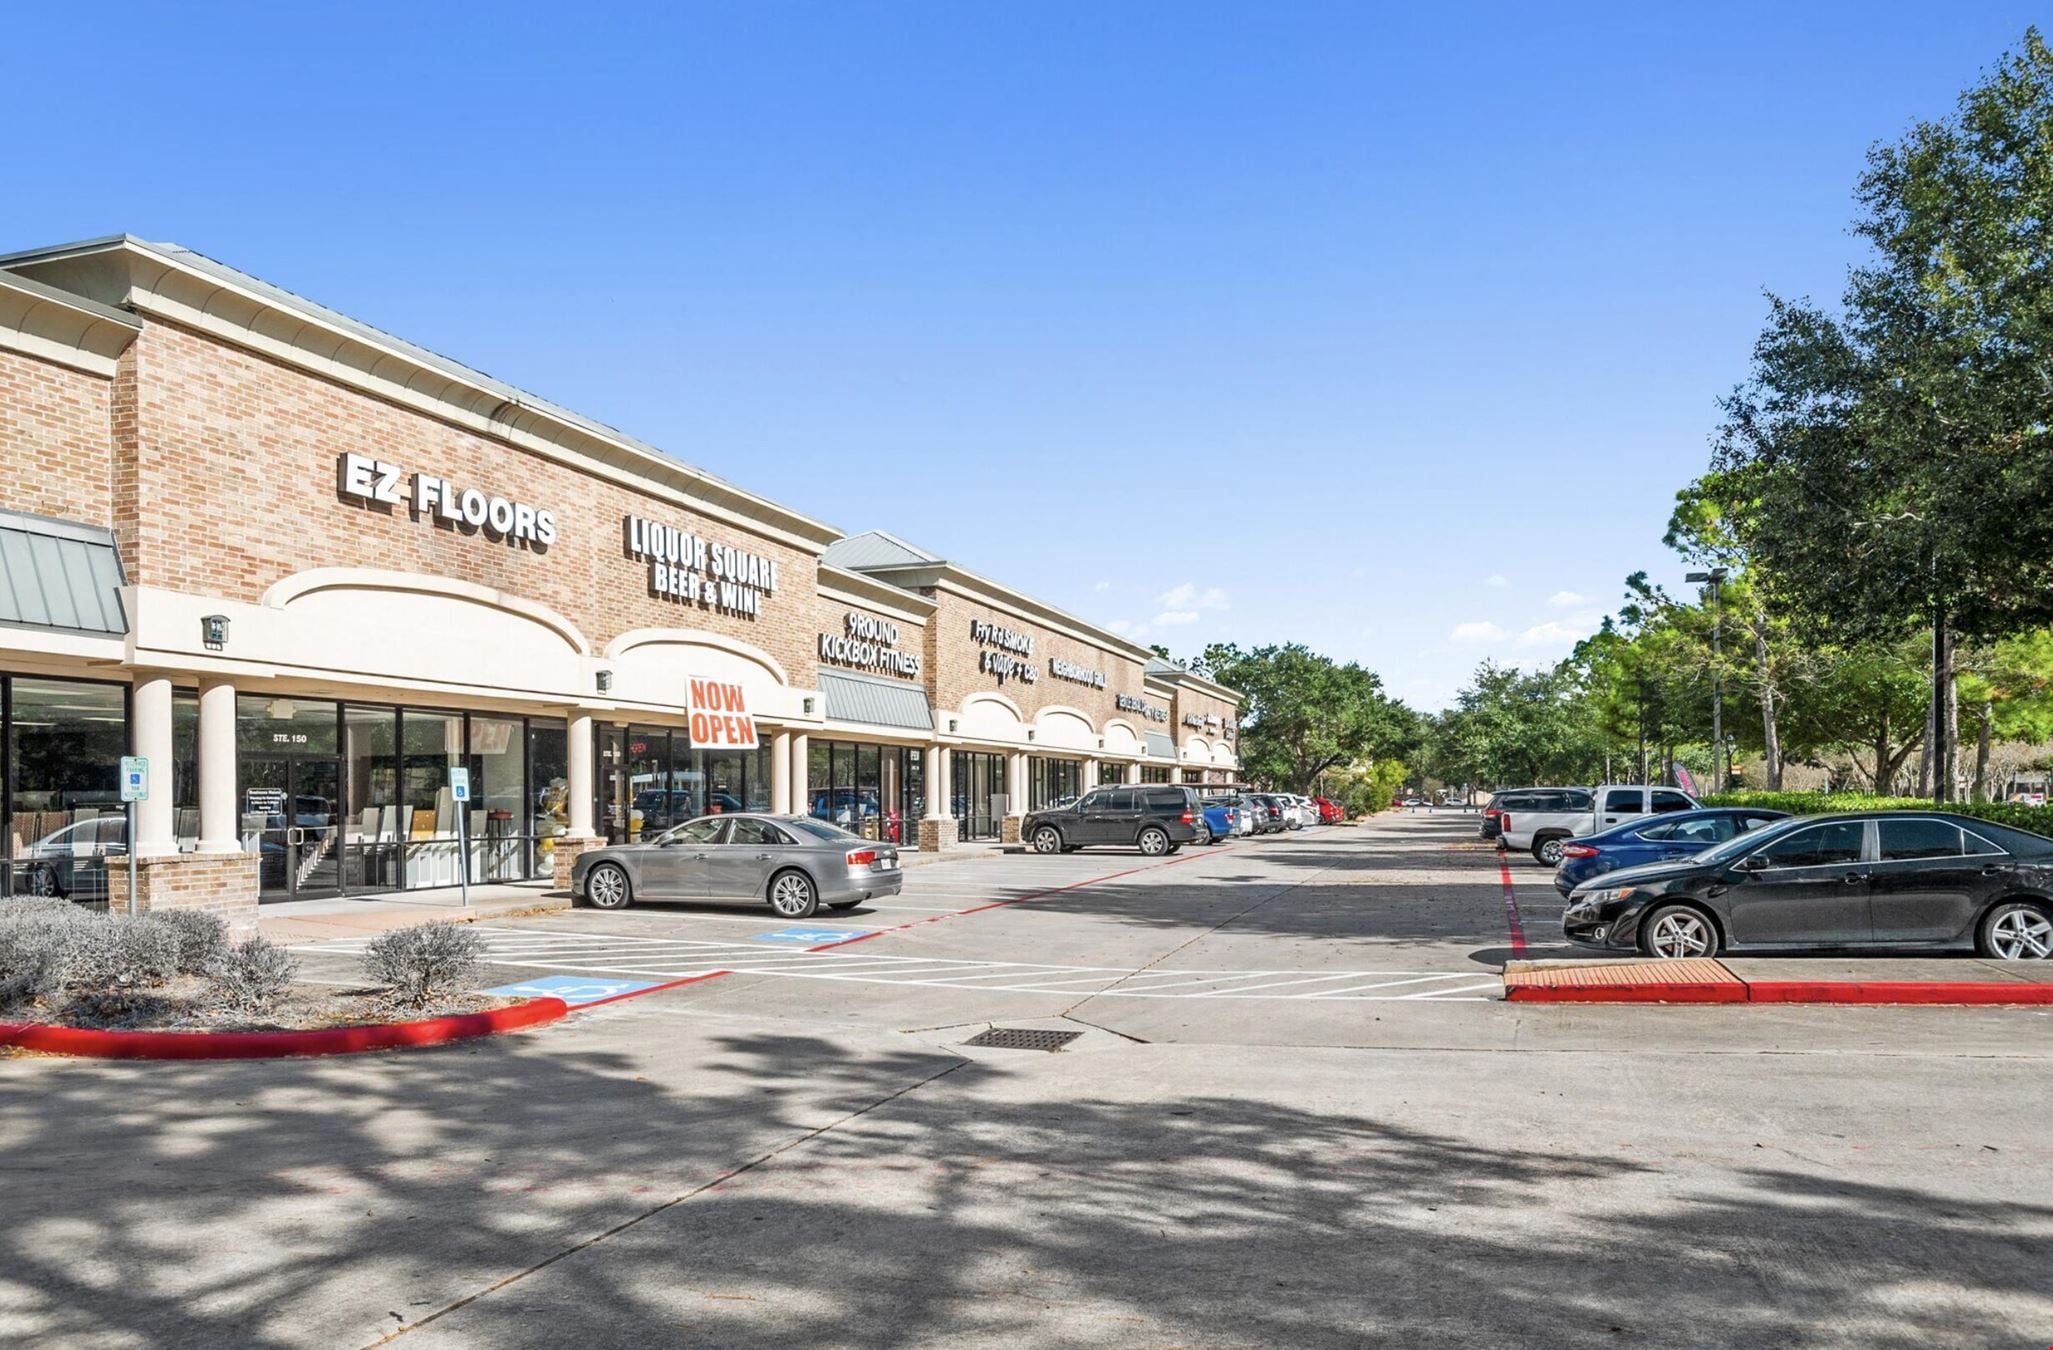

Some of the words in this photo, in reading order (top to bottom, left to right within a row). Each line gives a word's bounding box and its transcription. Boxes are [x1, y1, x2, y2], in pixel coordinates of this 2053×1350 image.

[345, 452, 401, 504] EZ
[417, 473, 557, 545] FLOORS
[630, 515, 706, 571] LIQUOR
[711, 542, 781, 592] SQUARE
[654, 562, 701, 601] BEER
[704, 581, 718, 605] &
[720, 581, 762, 616] WINE
[848, 612, 899, 645] 9ROUND
[1004, 630, 1035, 654] SMOKE
[821, 633, 878, 667] KICKBOX
[880, 647, 921, 675] FITNESS
[690, 679, 745, 713] NOW
[273, 733, 290, 743] STE.
[292, 734, 307, 743] 150
[691, 712, 755, 745] OPEN
